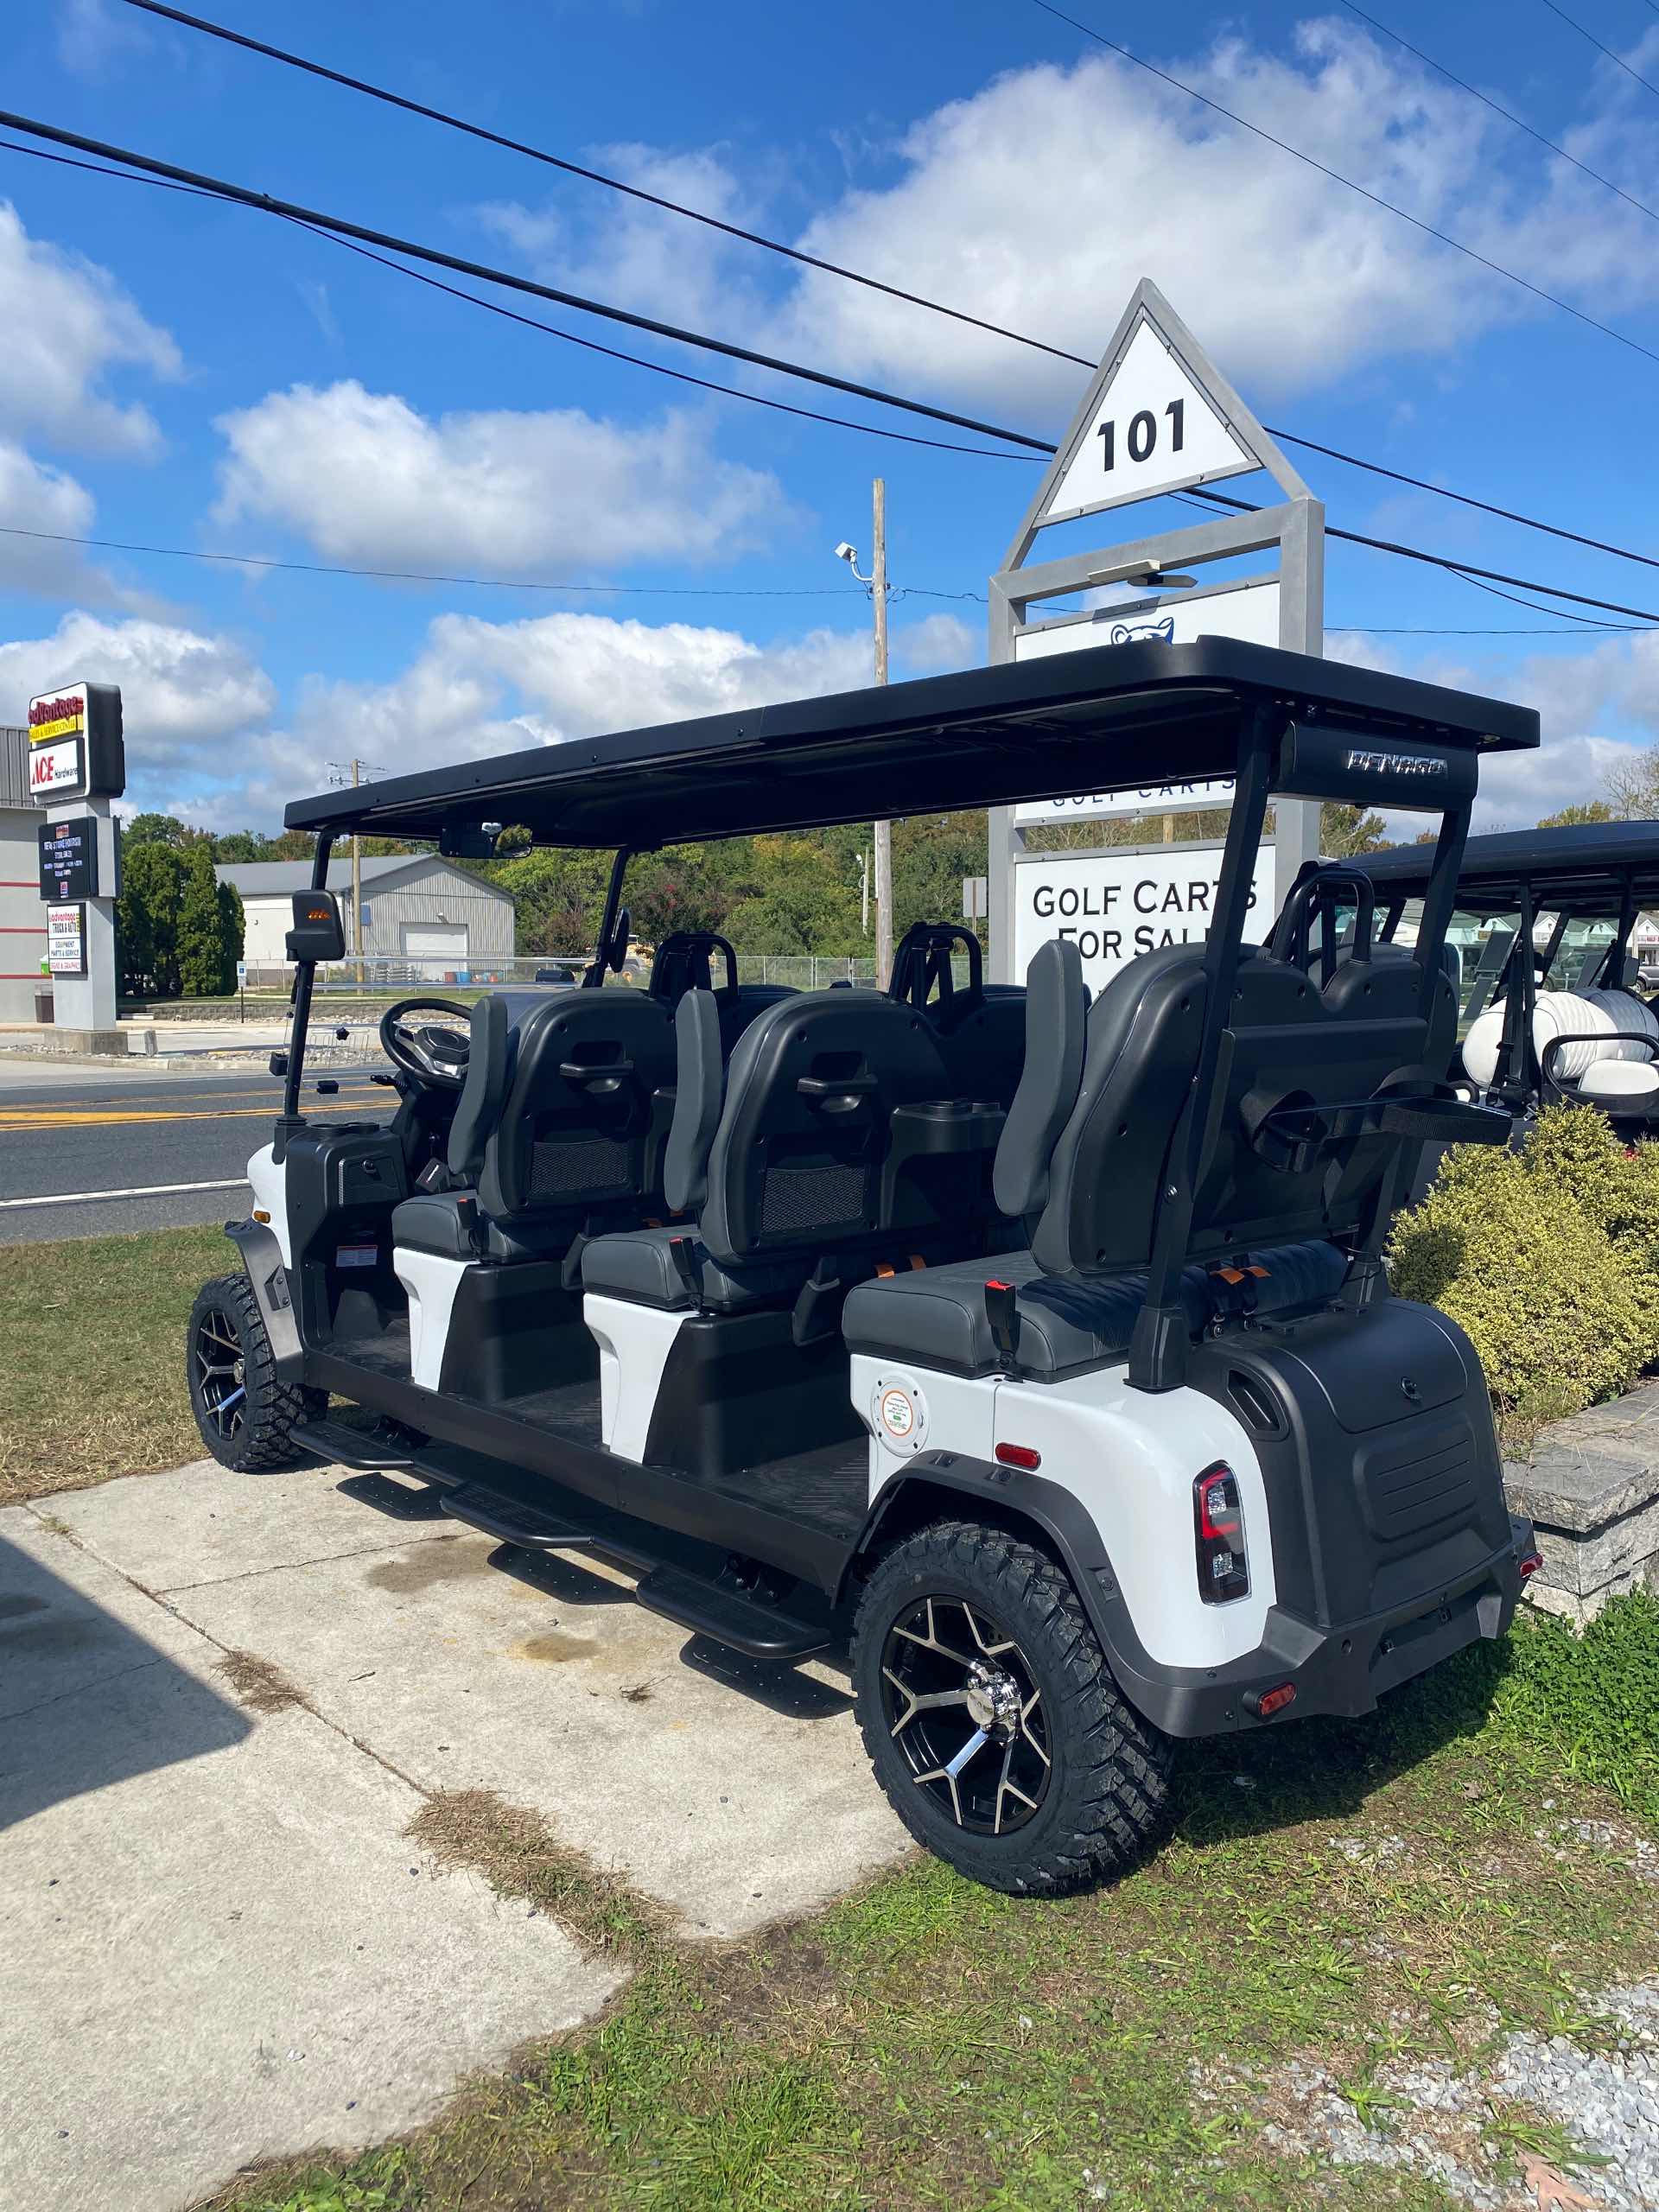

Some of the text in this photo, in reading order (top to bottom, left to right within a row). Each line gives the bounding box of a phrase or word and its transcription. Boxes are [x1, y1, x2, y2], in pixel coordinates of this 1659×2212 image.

[1097, 398, 1184, 472] 101
[31, 754, 54, 785] ACE
[1033, 880, 1257, 918] GOLF CARS
